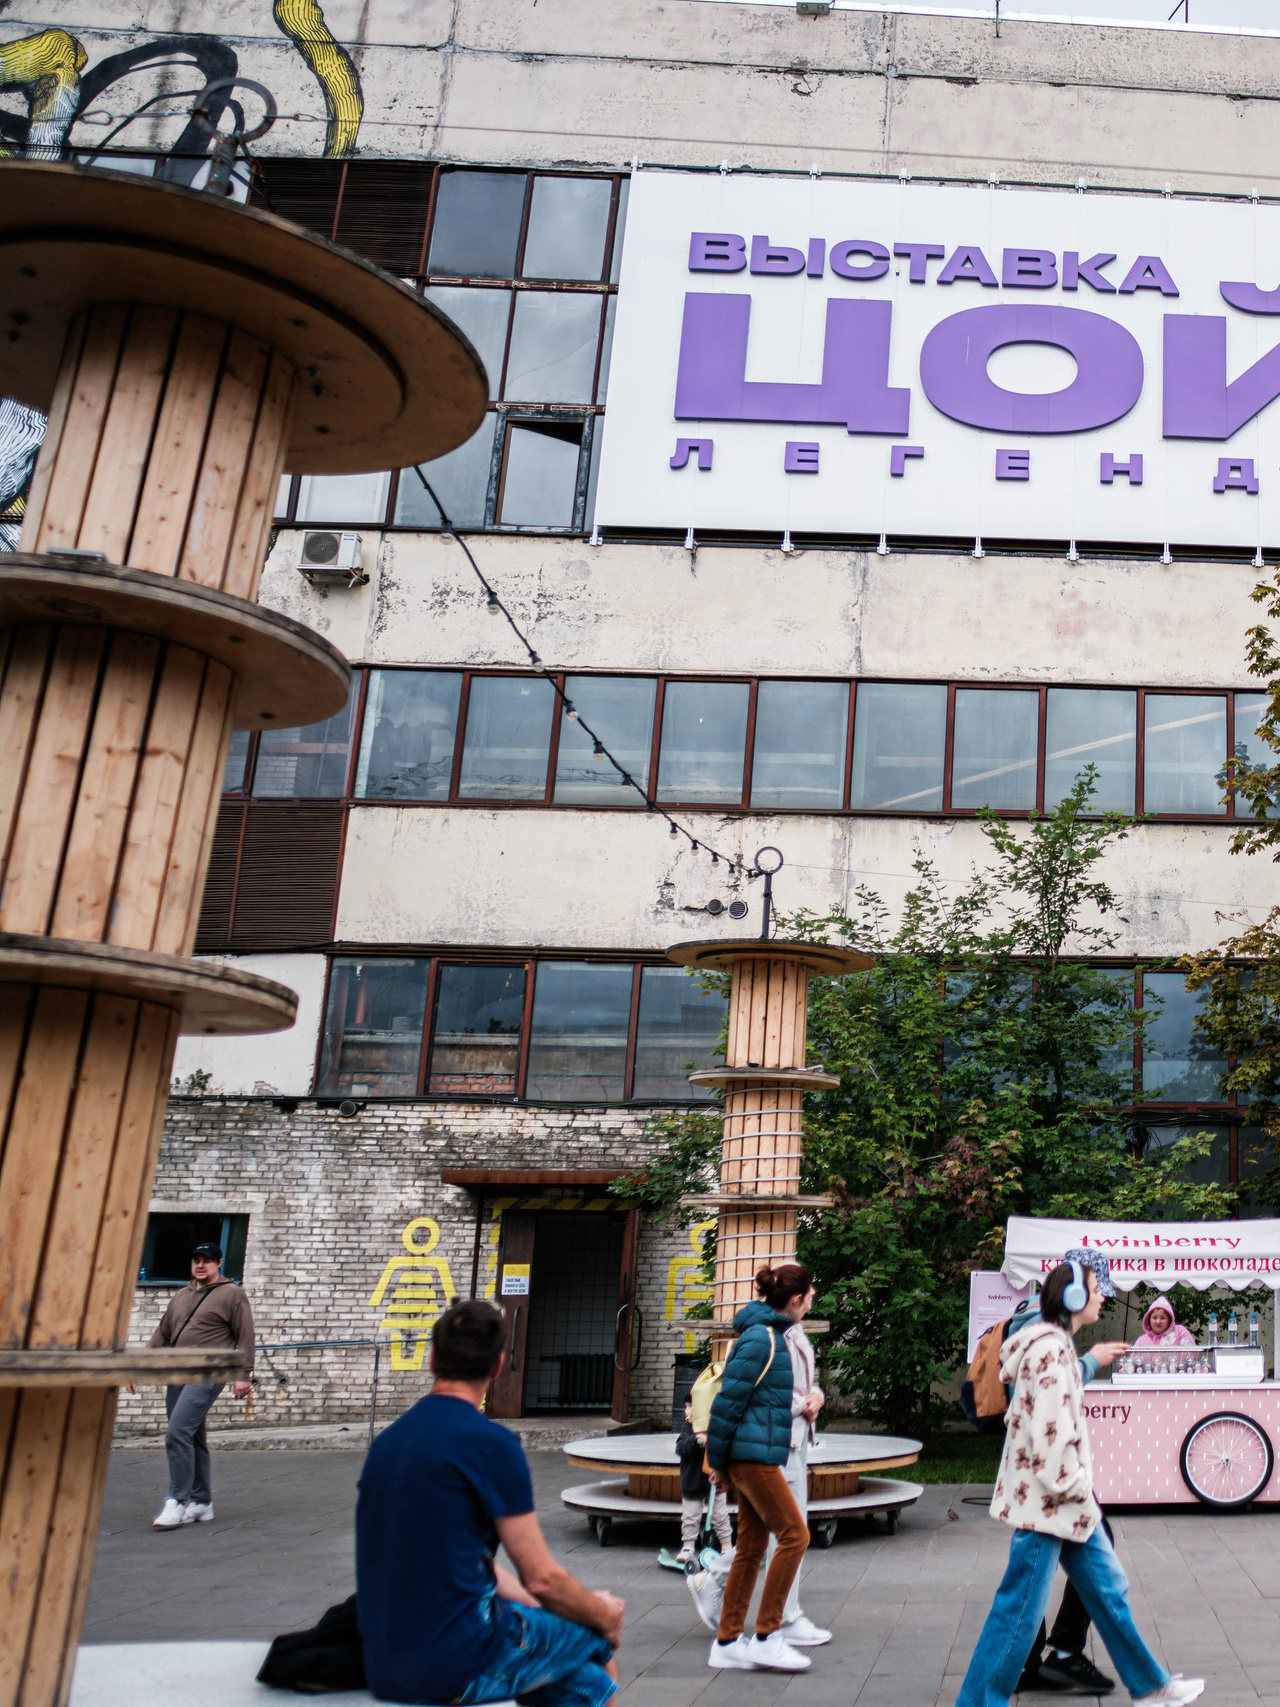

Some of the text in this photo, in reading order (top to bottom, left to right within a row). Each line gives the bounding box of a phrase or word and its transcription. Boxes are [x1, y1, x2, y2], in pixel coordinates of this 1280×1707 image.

[687, 231, 1180, 298] ВЫСТАВКА
[1079, 1234, 1242, 1250] twinberry
[1153, 1258, 1165, 1272] в
